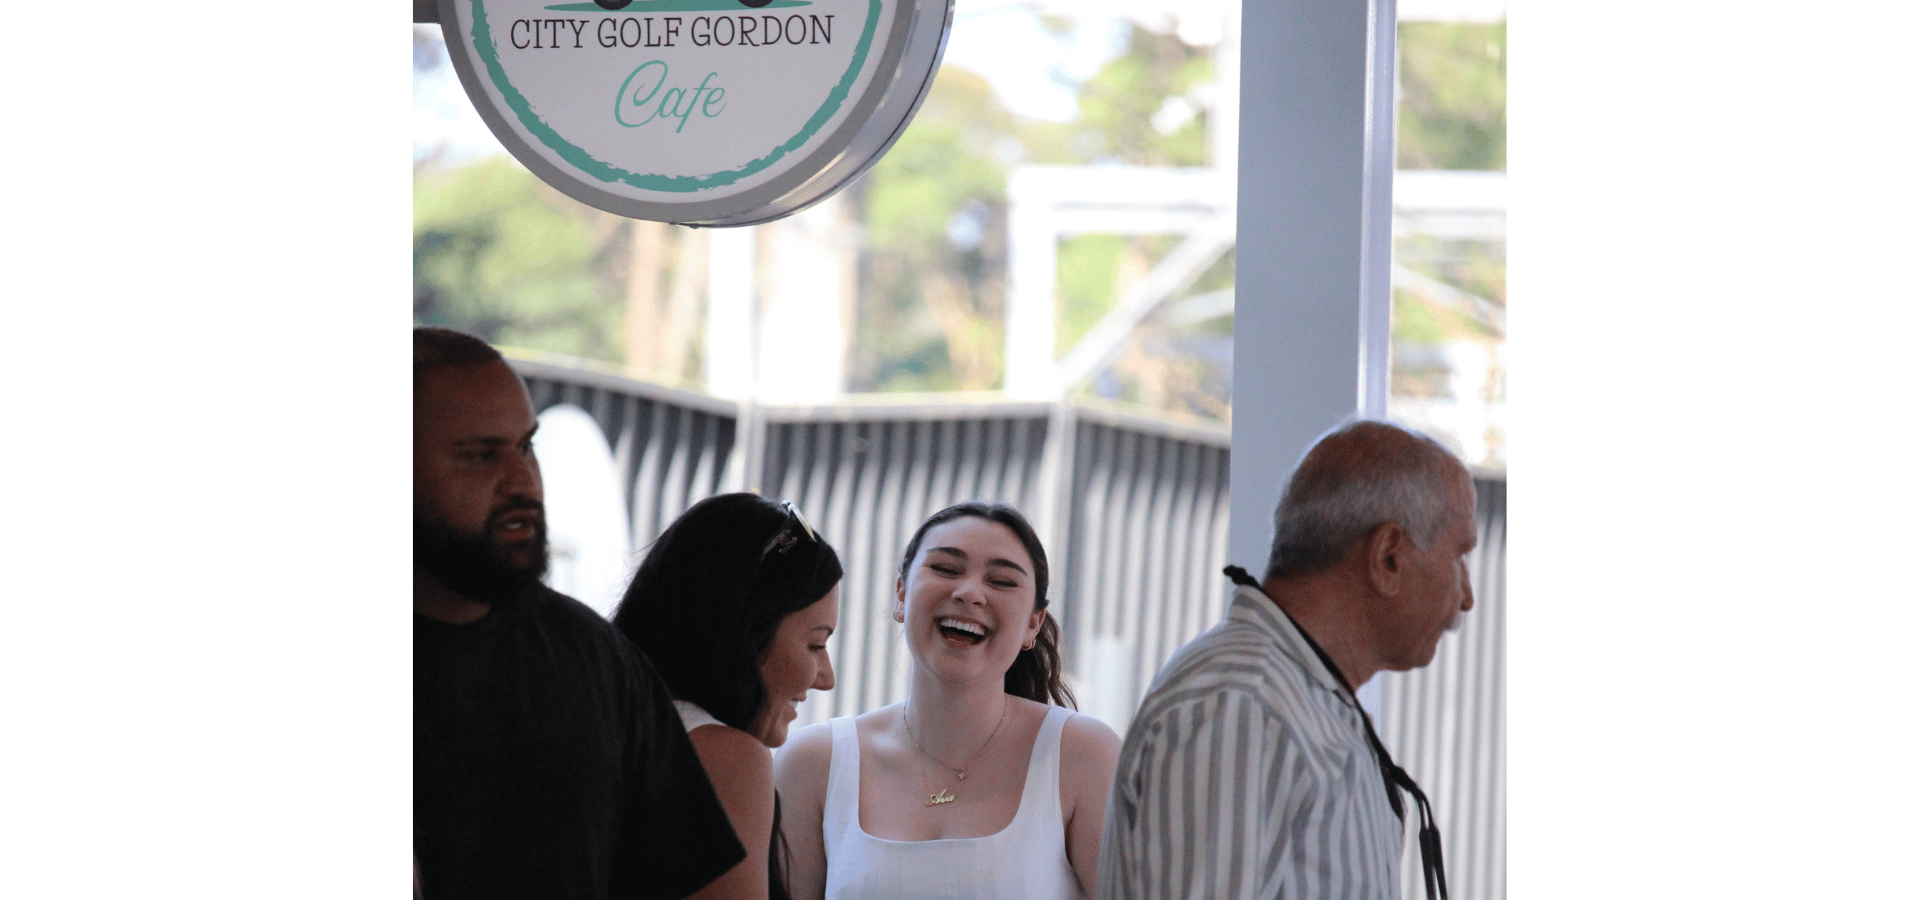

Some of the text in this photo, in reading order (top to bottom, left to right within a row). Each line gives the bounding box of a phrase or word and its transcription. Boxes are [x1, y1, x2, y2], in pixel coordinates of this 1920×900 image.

[510, 14, 835, 49] CITY GOLF GORDON
[614, 59, 727, 134] Cafe
